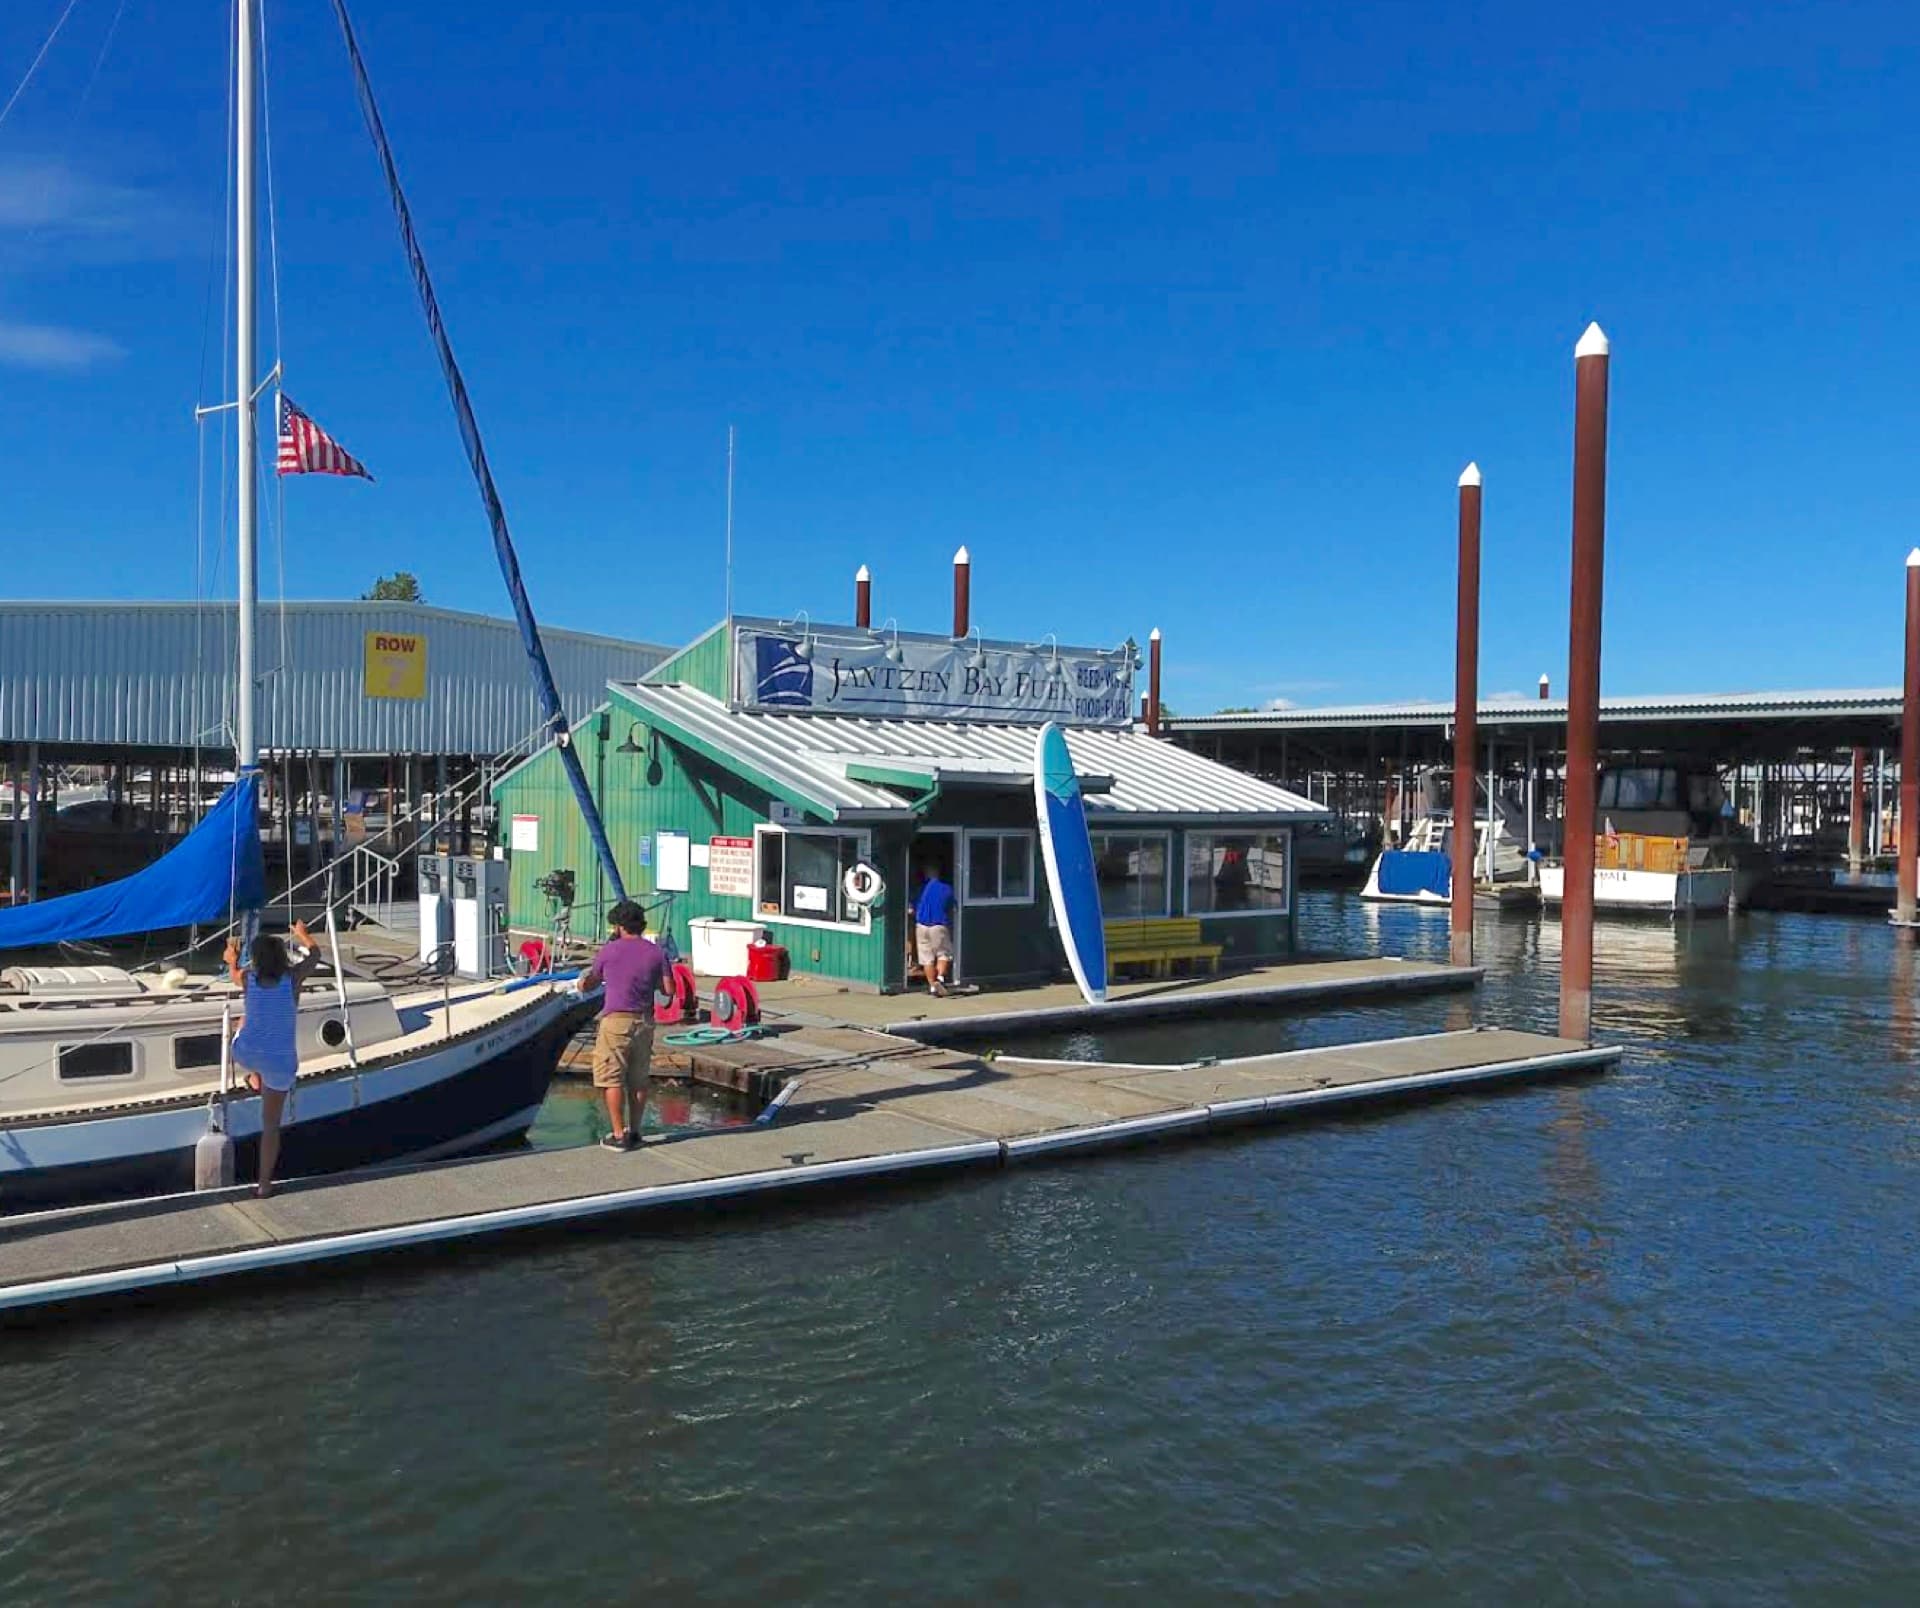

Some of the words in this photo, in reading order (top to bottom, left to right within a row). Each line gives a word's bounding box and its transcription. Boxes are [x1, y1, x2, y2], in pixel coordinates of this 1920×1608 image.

[376, 637, 416, 653] ROW
[826, 657, 952, 702] JANTZEN
[962, 666, 1008, 697] BAY
[1014, 672, 1072, 701] FUEL
